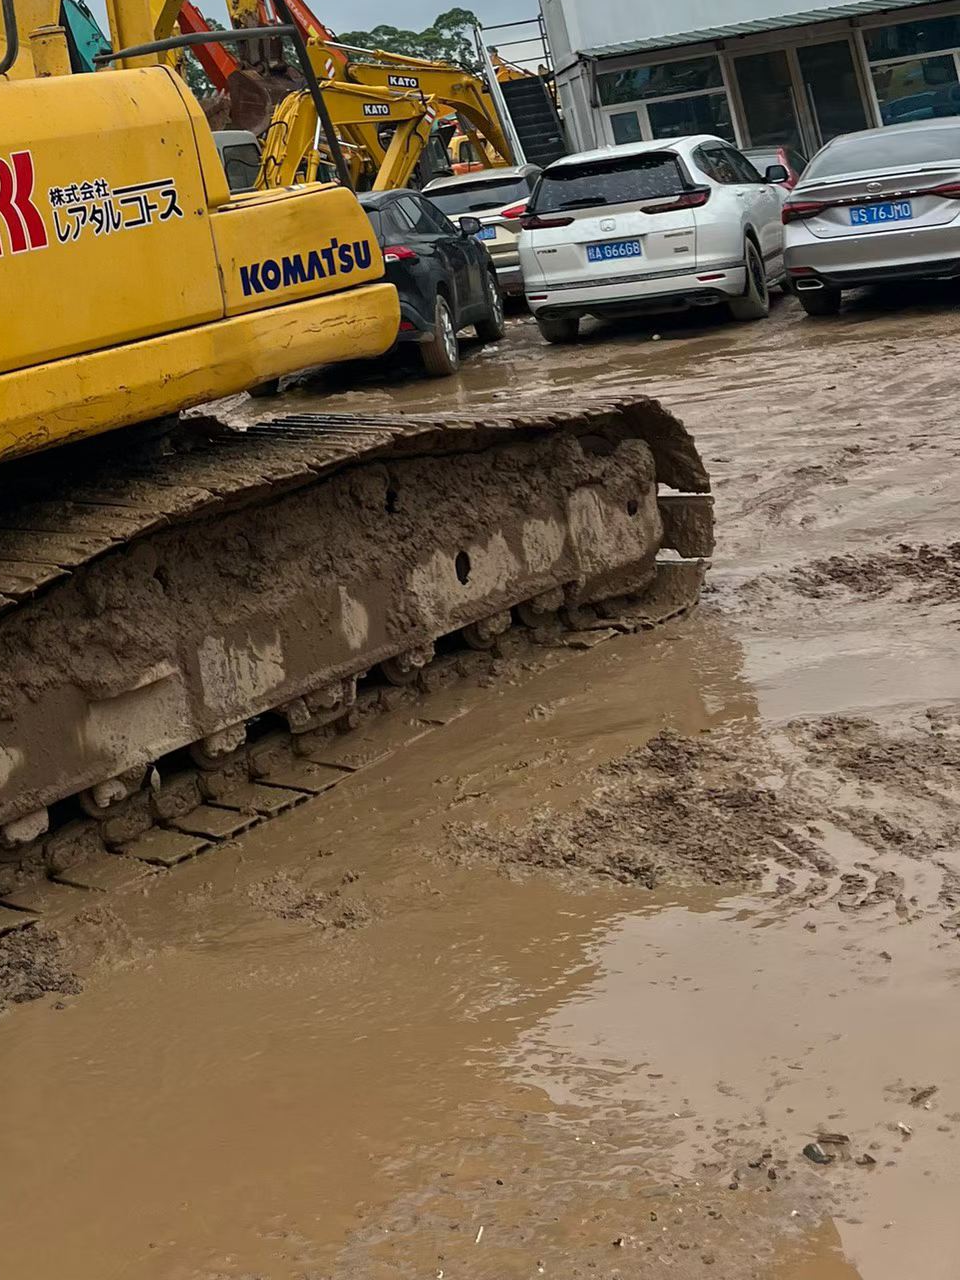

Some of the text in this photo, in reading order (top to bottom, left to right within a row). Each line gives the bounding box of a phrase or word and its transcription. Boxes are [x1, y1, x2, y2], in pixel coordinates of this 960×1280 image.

[389, 76, 417, 87] KATO
[364, 104, 389, 115] KATO
[49, 178, 110, 207] 株式会社
[240, 237, 372, 297] KOMATSU
